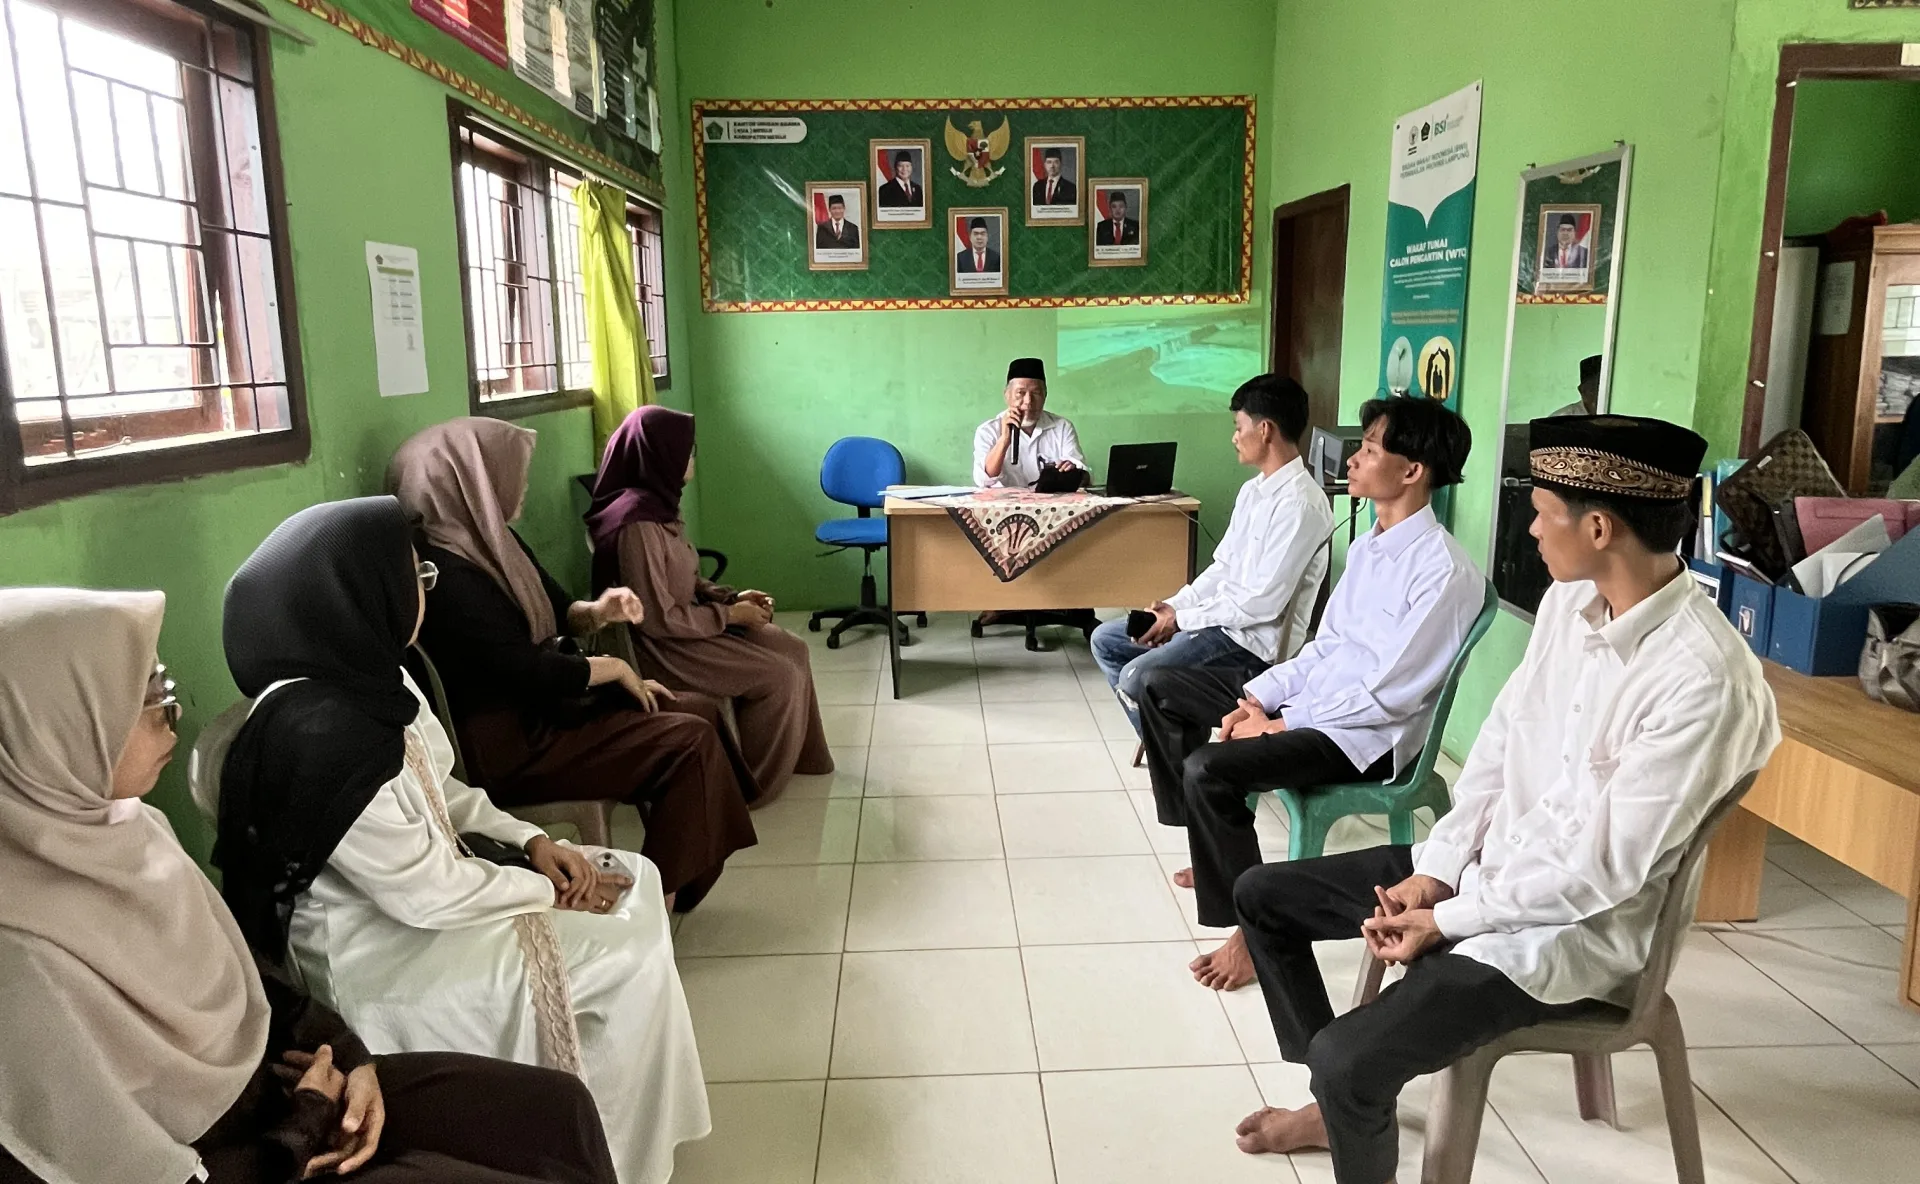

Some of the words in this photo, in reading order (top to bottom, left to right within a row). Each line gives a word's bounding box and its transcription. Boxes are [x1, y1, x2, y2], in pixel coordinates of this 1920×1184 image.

[1406, 242, 1427, 254] WAKAF
[1427, 238, 1448, 250] TUNAI
[1389, 256, 1410, 268] CALON
[1410, 250, 1444, 264] PENGANTIN
